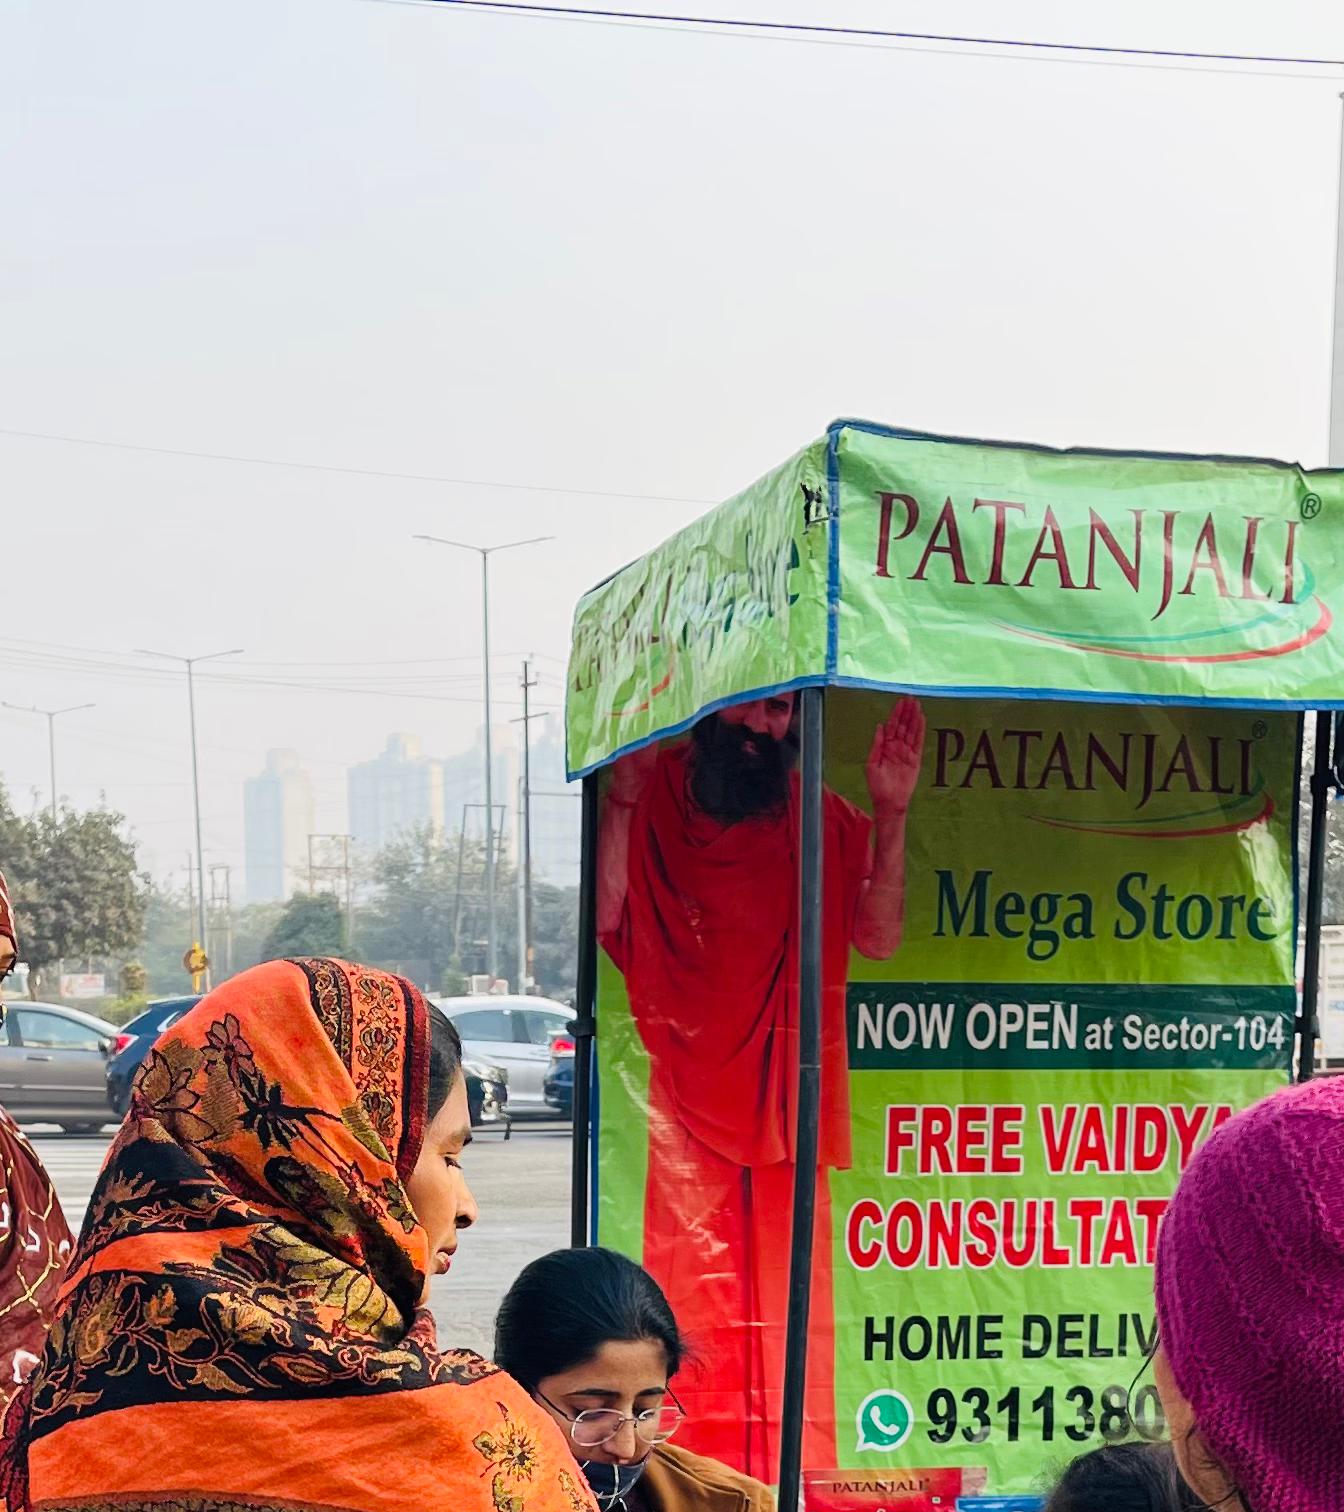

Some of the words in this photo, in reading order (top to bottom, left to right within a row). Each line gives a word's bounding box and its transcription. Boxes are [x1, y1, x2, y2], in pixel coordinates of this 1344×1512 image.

[875, 489, 1300, 621] PATANJALI
[932, 726, 1256, 811] PATANJALI
[932, 869, 1096, 960] Mega
[1113, 870, 1279, 942] Store
[856, 1002, 956, 1051] NOW
[965, 1002, 1079, 1051] OPEN
[1085, 1023, 1114, 1051] at
[1122, 1013, 1285, 1051] Sector-104
[885, 1104, 1025, 1175] FREE
[846, 1197, 1168, 1270] CONSULTAT
[863, 1314, 1004, 1362] HOME
[1022, 1312, 1159, 1360] DELIV
[926, 1385, 1166, 1444] 9311380
[832, 1479, 927, 1494] PATANJALI
